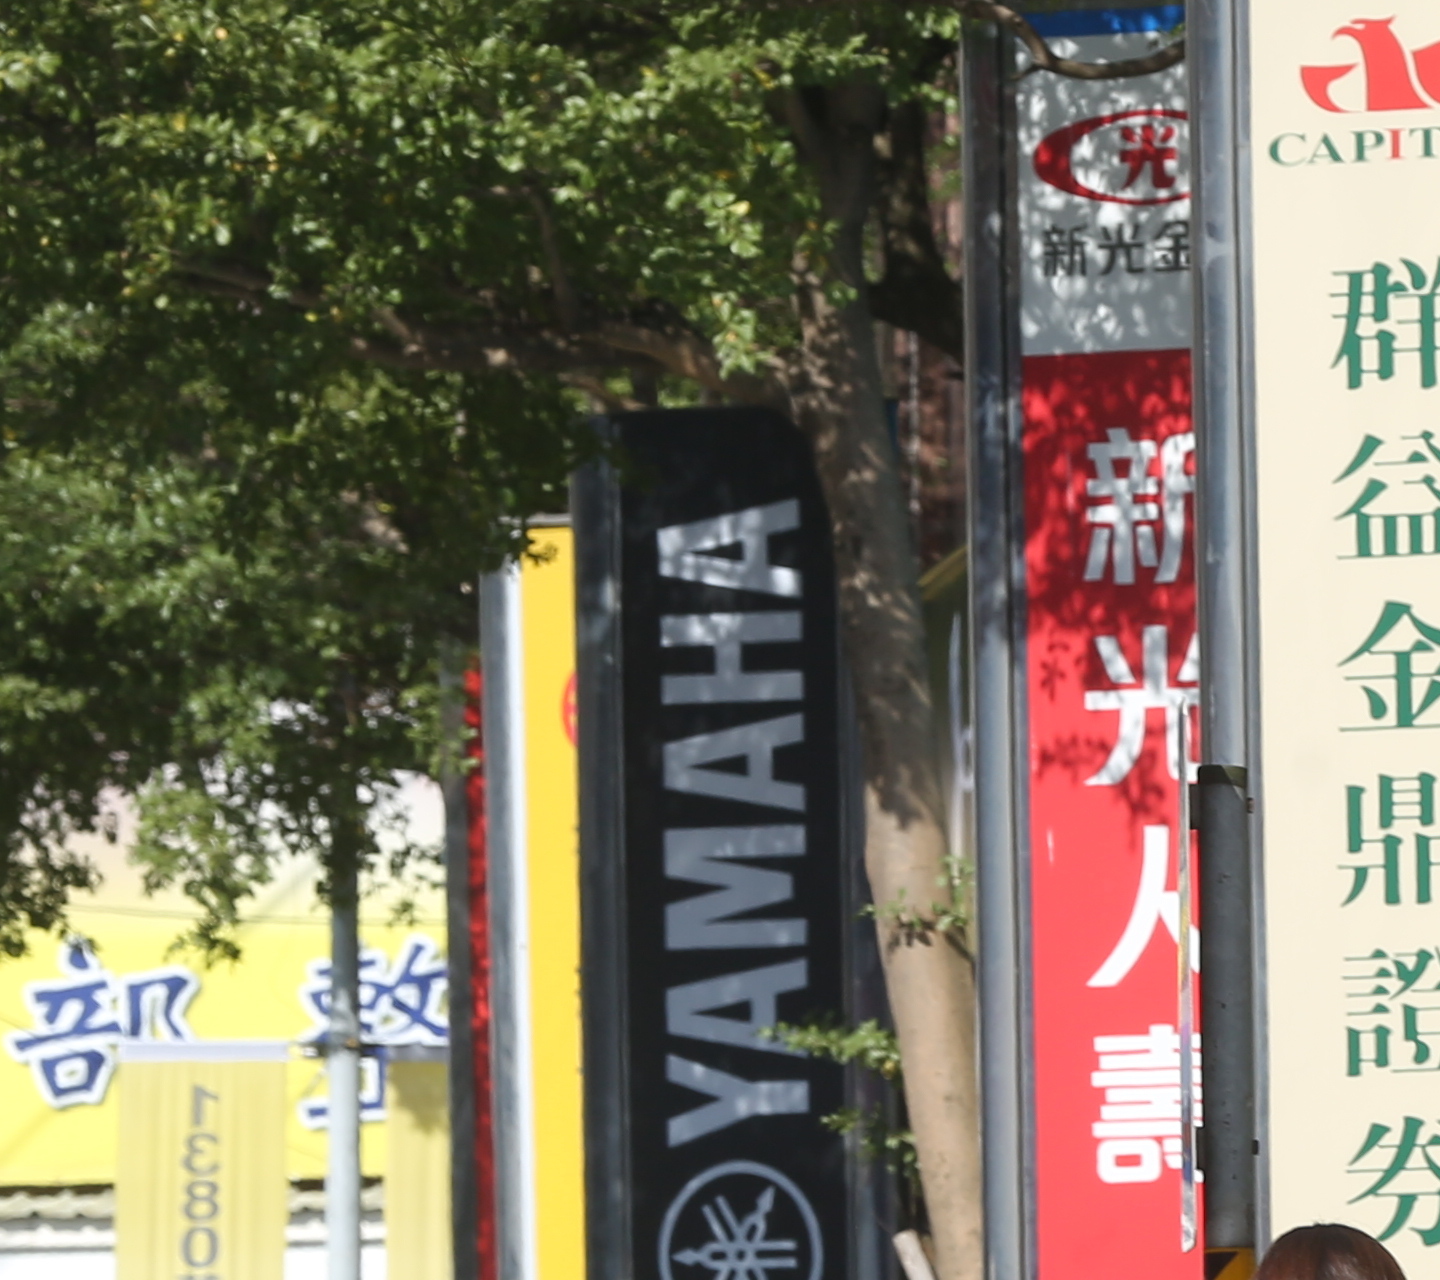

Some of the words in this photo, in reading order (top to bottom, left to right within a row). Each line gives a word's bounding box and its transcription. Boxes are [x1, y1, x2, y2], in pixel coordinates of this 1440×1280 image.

[1119, 122, 1178, 192] 光
[656, 498, 811, 1148] YAMAHA
[1084, 427, 1205, 1184] 新光人壽
